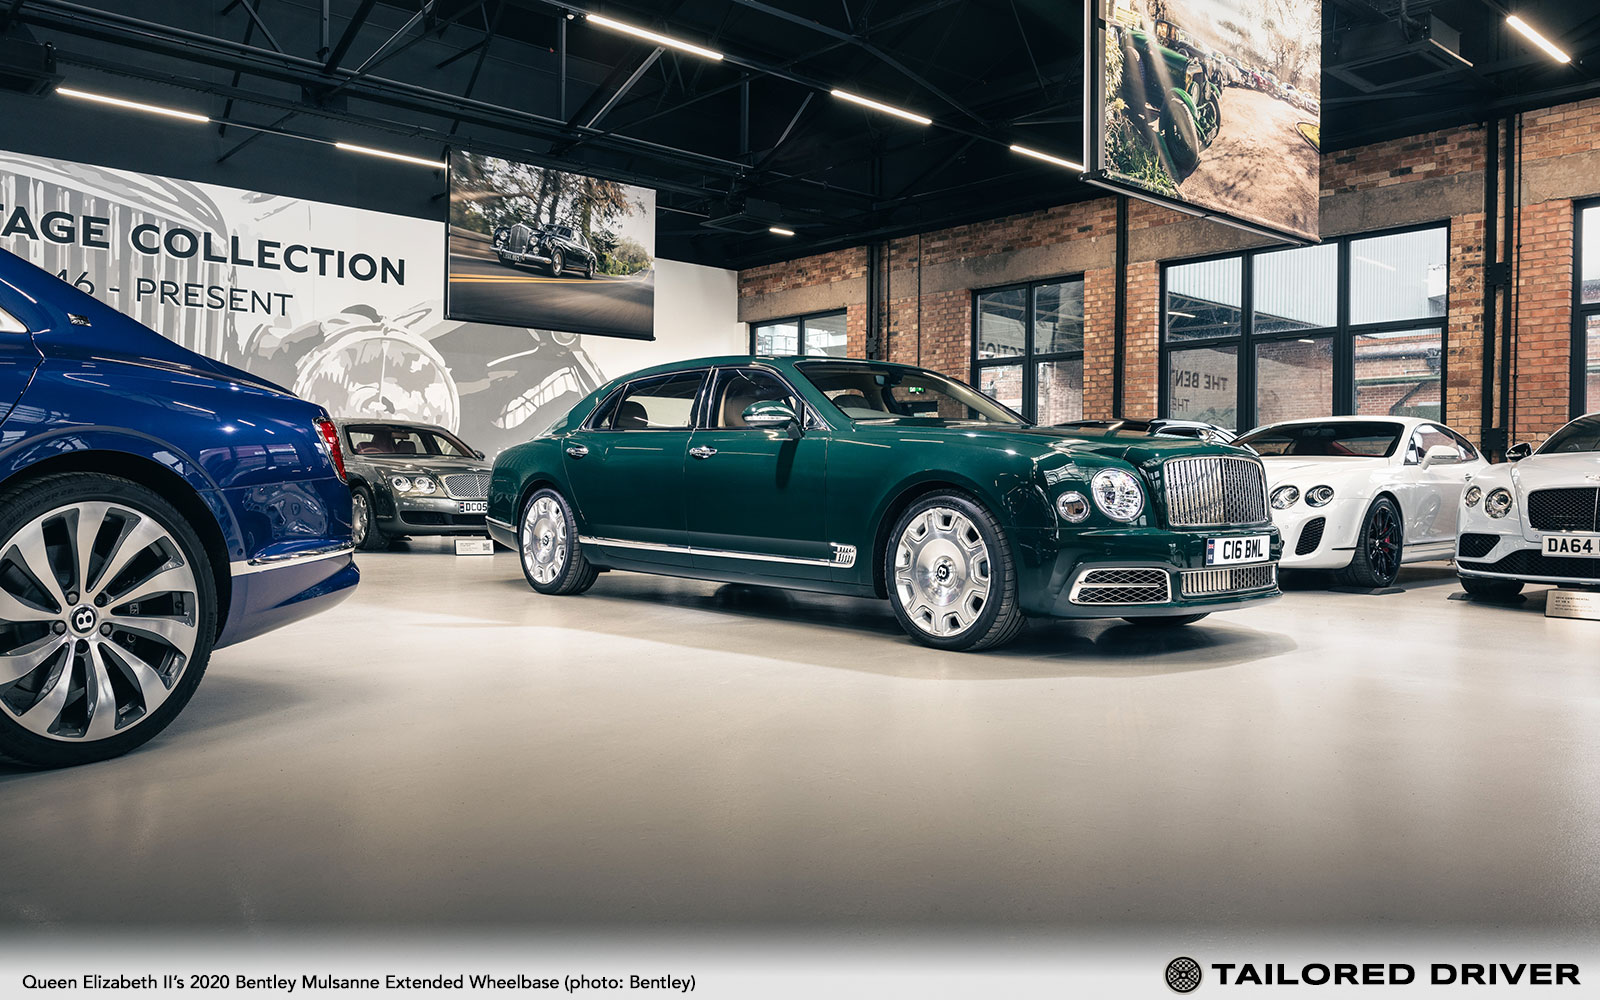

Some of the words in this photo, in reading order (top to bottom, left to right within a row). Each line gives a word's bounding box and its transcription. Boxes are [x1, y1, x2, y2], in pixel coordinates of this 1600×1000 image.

[0, 203, 110, 249] AGE
[131, 223, 405, 286] COLLECTION
[136, 278, 294, 316] PRESENT
[1224, 541, 1242, 559] C16
[1245, 539, 1263, 558] BML
[1548, 538, 1593, 553] DA64
